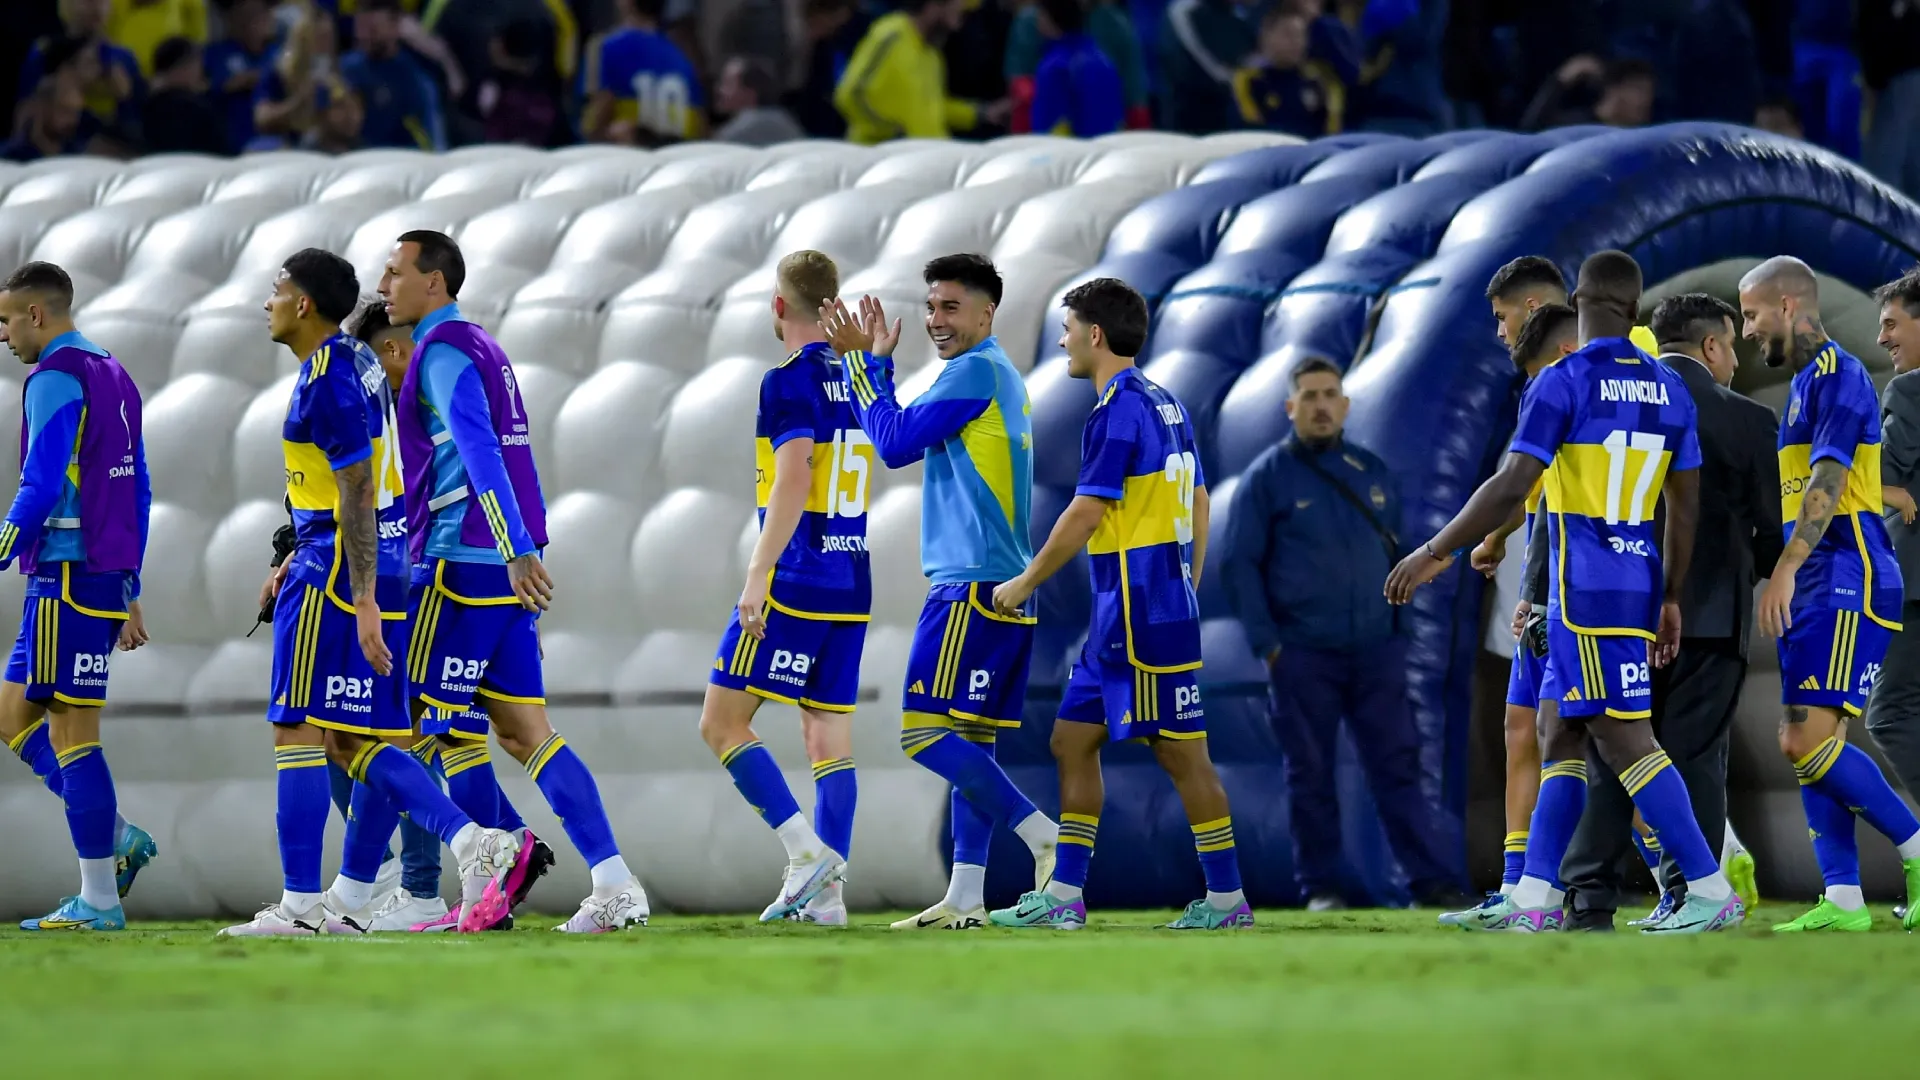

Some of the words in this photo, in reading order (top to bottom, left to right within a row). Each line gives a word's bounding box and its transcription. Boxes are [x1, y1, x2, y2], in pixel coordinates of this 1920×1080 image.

[630, 71, 689, 133] 10
[823, 381, 851, 402] VALE
[1600, 379, 1670, 406] ADVINCULA
[827, 428, 872, 519] 15
[1602, 429, 1666, 526] 17
[441, 656, 489, 681] pax
[769, 649, 816, 674] pa
[325, 675, 373, 700] pax
[1620, 661, 1650, 690] pa
[1175, 684, 1202, 712] pa
